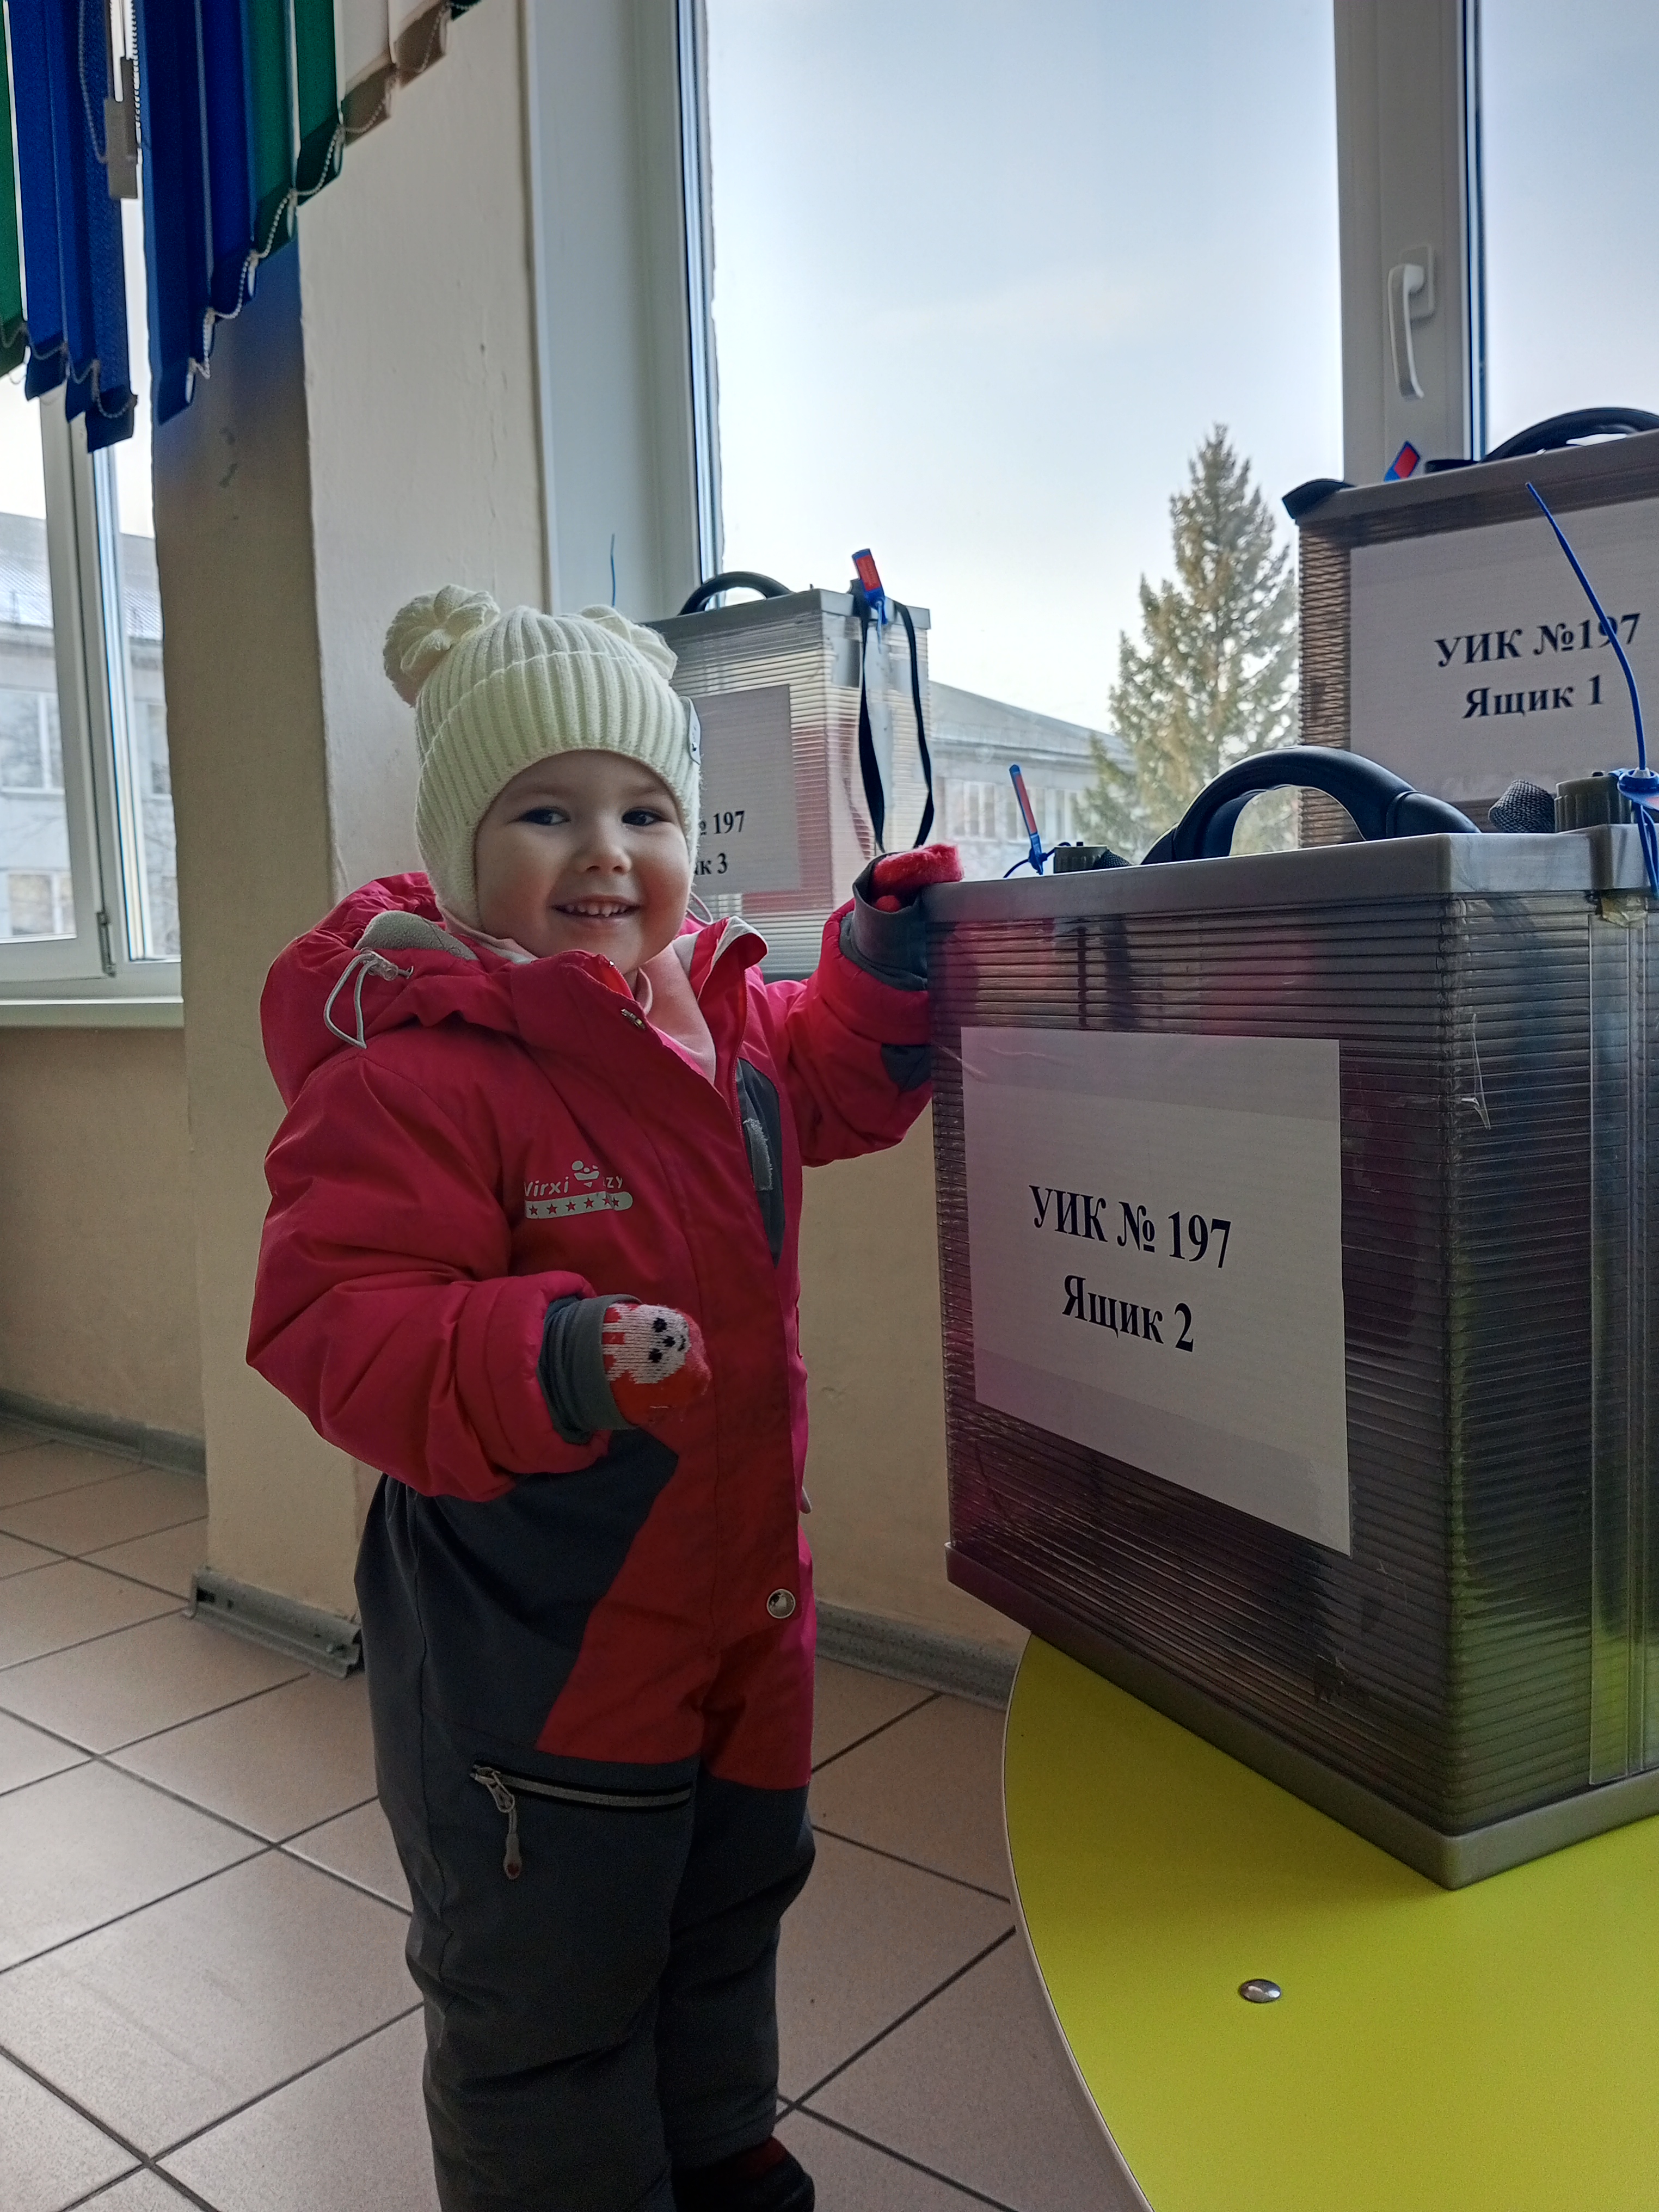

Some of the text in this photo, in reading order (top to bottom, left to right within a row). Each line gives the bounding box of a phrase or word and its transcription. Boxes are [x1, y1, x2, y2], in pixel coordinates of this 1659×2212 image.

[1434, 628, 1523, 667] УИК
[1462, 674, 1603, 719] Ящик 1
[712, 810, 745, 835] 197
[717, 852, 728, 874] 3
[1028, 1184, 1232, 1268] УИК № 197
[1061, 1274, 1194, 1353] Ящик 2
